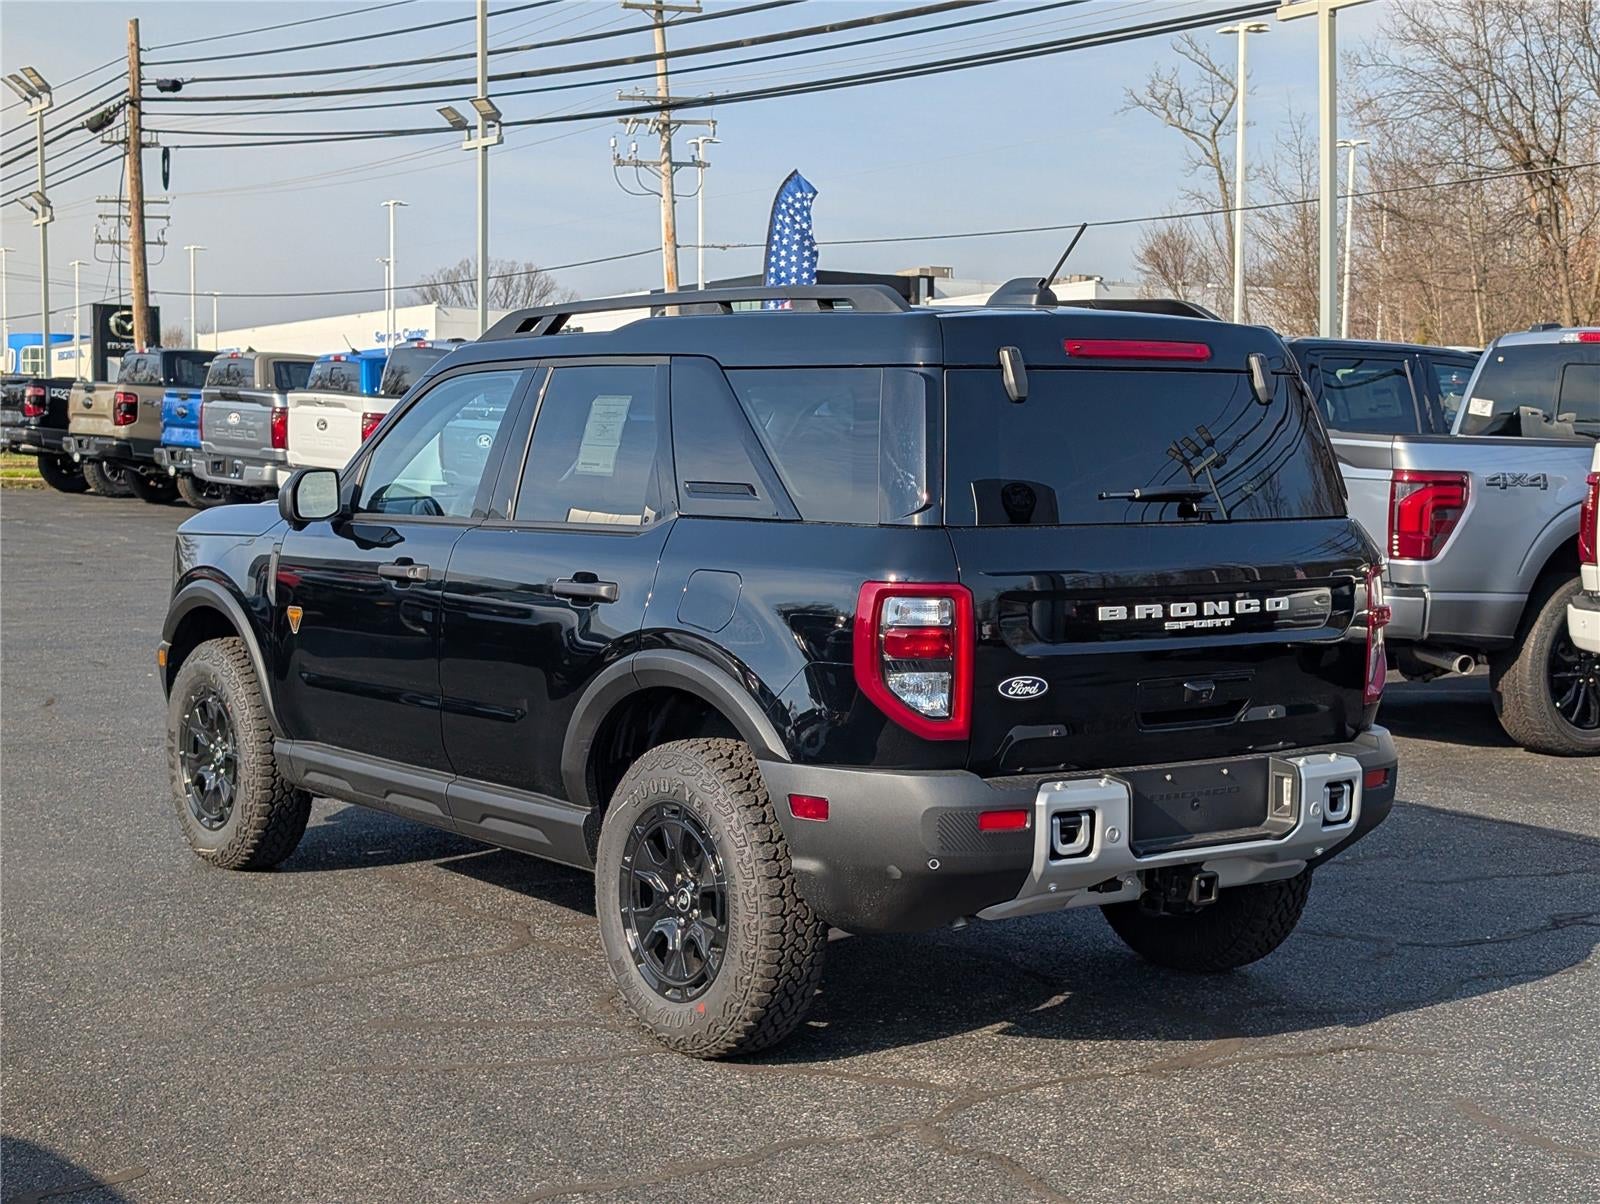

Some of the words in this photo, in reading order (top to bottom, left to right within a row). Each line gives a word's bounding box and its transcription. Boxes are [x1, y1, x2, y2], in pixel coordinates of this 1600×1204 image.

[375, 331, 402, 343] Servce
[1098, 597, 1289, 621] BRONCO
[1164, 617, 1235, 630] SPORT
[1008, 679, 1040, 695] Ford
